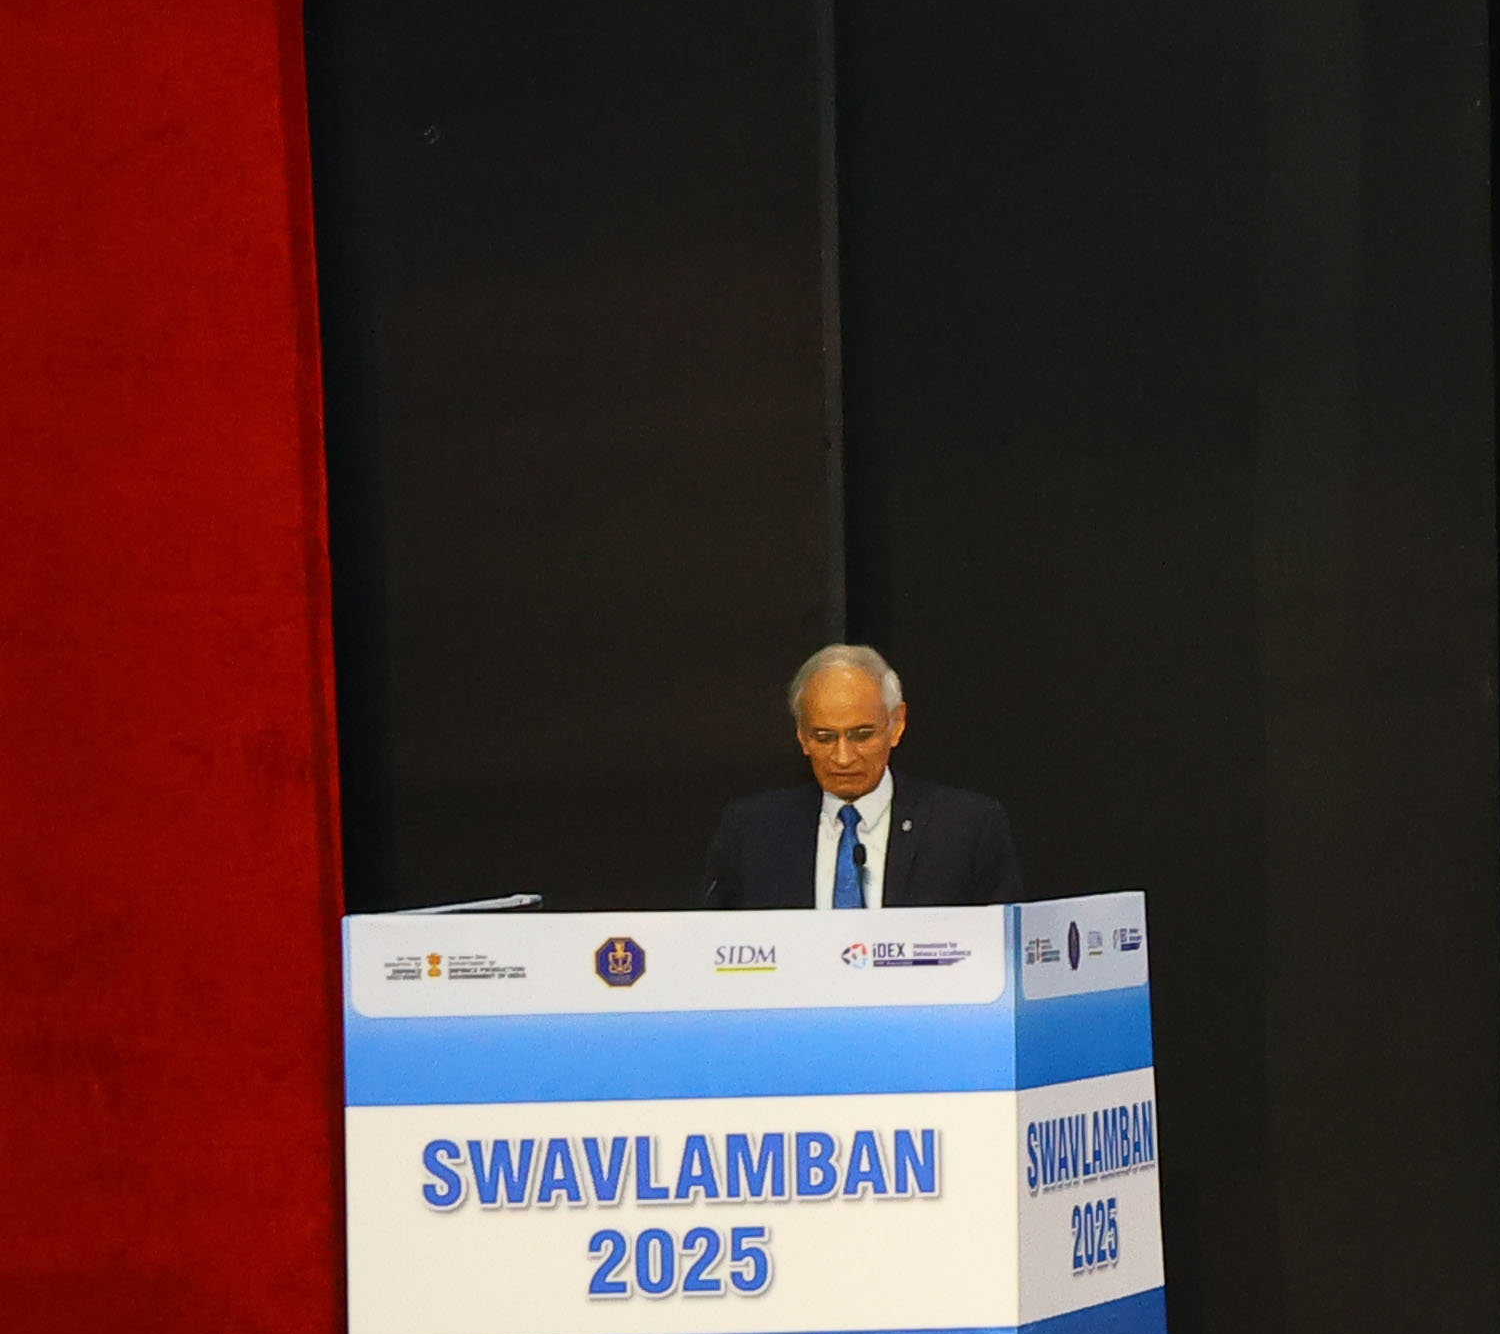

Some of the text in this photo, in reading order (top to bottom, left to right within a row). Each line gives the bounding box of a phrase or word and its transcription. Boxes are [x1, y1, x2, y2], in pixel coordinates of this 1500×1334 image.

[714, 945, 776, 965] SIDM
[873, 942, 906, 958] iDEX
[421, 1127, 941, 1209] SWAVLAMBAN
[1026, 1100, 1156, 1193] SWAVLAMBAN
[587, 1224, 771, 1301] 2025
[1070, 1197, 1121, 1276] 2025
